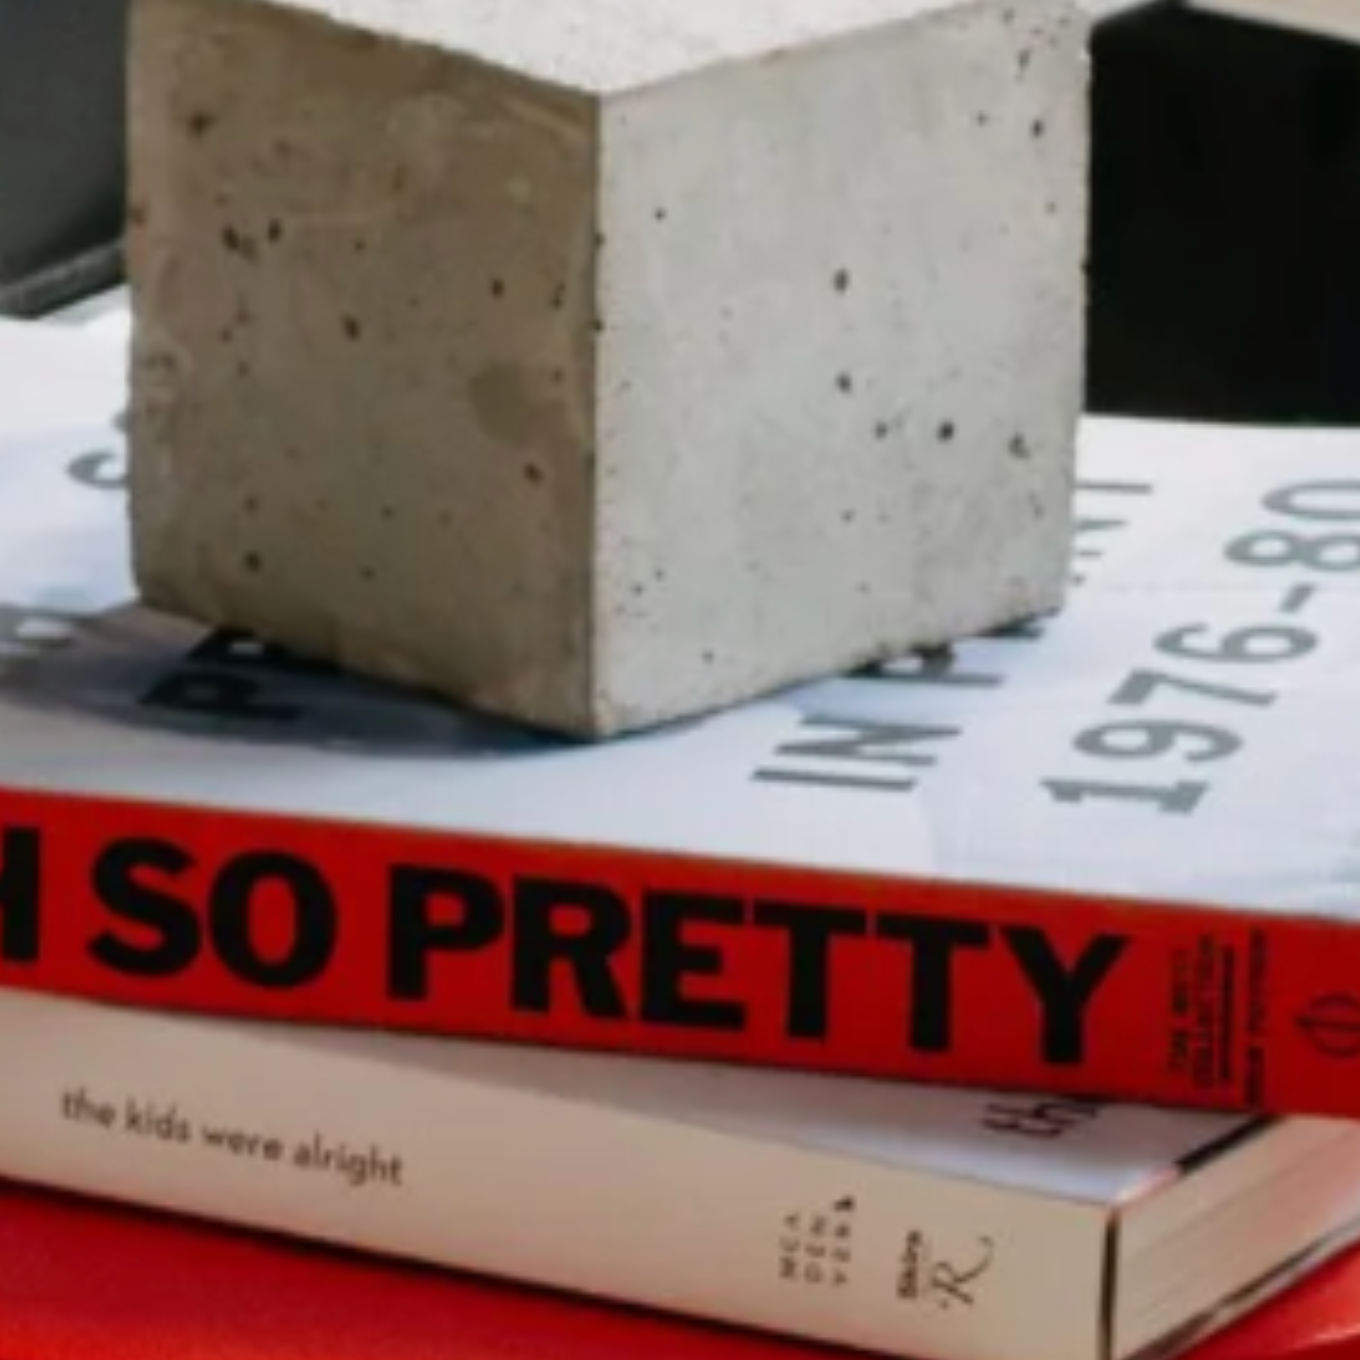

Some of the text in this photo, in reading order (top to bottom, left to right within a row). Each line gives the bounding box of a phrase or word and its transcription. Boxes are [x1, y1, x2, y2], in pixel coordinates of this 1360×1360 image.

[749, 713, 964, 792] IN
[87, 836, 337, 990] SO
[386, 863, 1136, 1066] PRETTY
[61, 1087, 403, 1188] the kids were alright
